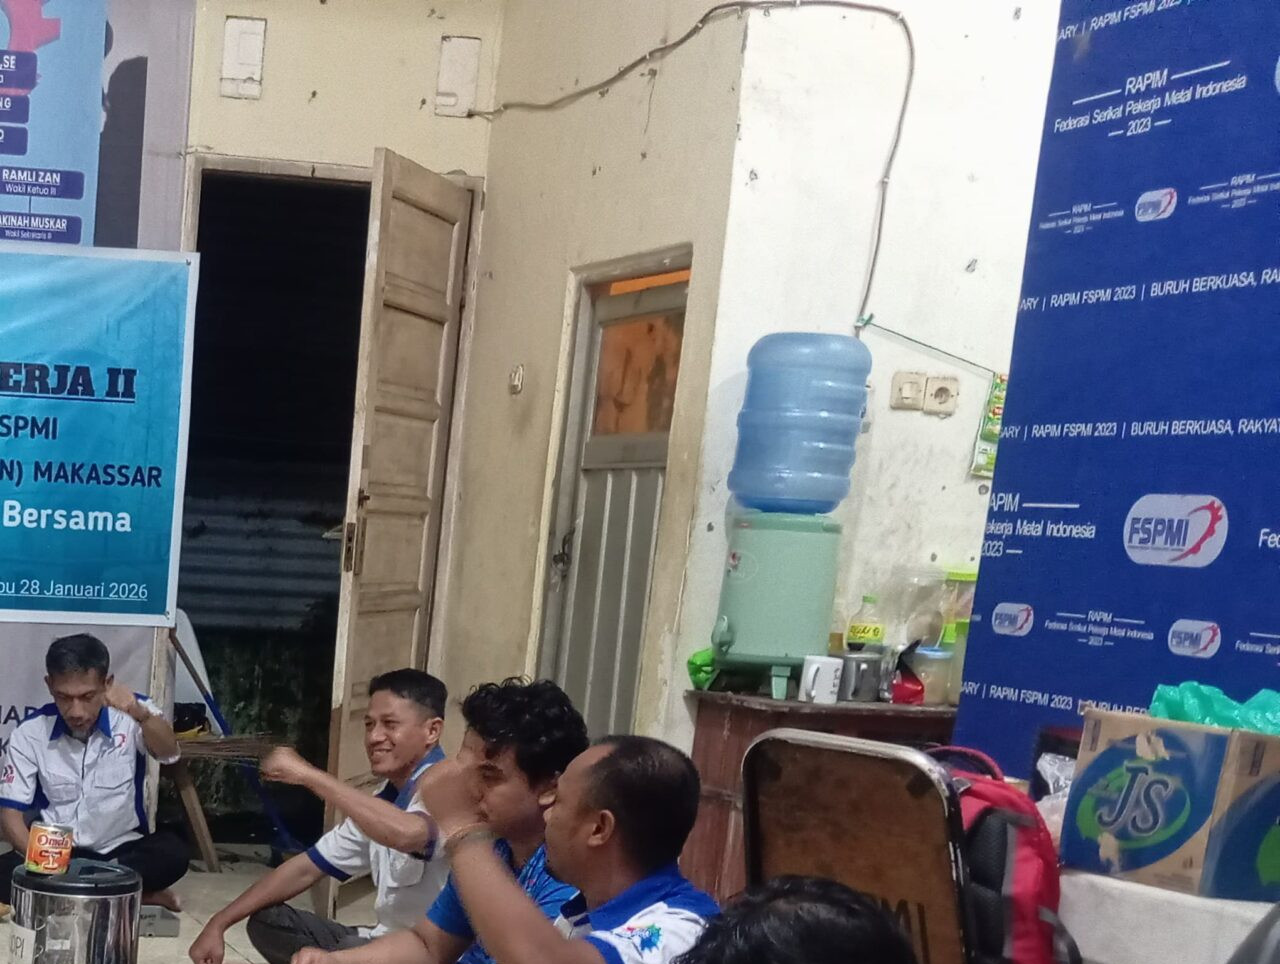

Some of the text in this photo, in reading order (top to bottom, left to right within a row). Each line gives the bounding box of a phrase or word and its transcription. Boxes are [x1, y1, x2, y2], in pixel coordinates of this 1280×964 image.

[1089, 11, 1121, 31] RAPIM
[1123, 2, 1156, 21] FSPMI
[1125, 68, 1169, 96] RAPIM
[1054, 73, 1247, 133] Federasi Serikat Pekerja Metal Indonesia
[1126, 117, 1152, 137] 2023
[2, 169, 61, 184] RAMLI ZAN
[5, 183, 26, 194] Wakil
[27, 185, 49, 196] Ketua
[31, 216, 68, 231] MUSKAR
[1050, 291, 1080, 308] RAPIM
[1082, 287, 1112, 304] FSPMI
[1113, 285, 1137, 301] 2023
[1150, 278, 1190, 297] BURUH
[1192, 270, 1257, 293] BERKUASA,
[104, 367, 137, 399] II
[1031, 424, 1061, 438] RAPIM
[1063, 422, 1093, 438] FSPMI
[1094, 421, 1117, 437] 2023
[1130, 420, 1169, 437] BURUH
[1171, 418, 1235, 437] BERKUASA,
[33, 460, 163, 489] MAKASSAR
[2, 499, 132, 534] Bersama
[1015, 518, 1045, 536] Metal
[1046, 520, 1096, 539] Indonesia
[1127, 516, 1190, 547] FSPMI
[20, 578, 41, 597] 28
[44, 580, 105, 600] Januari
[109, 582, 149, 601] 2026
[1087, 610, 1113, 623] RAPIM
[989, 685, 1018, 701] RAPIM
[1020, 690, 1049, 706] FSPMI
[1050, 694, 1073, 710] 2023
